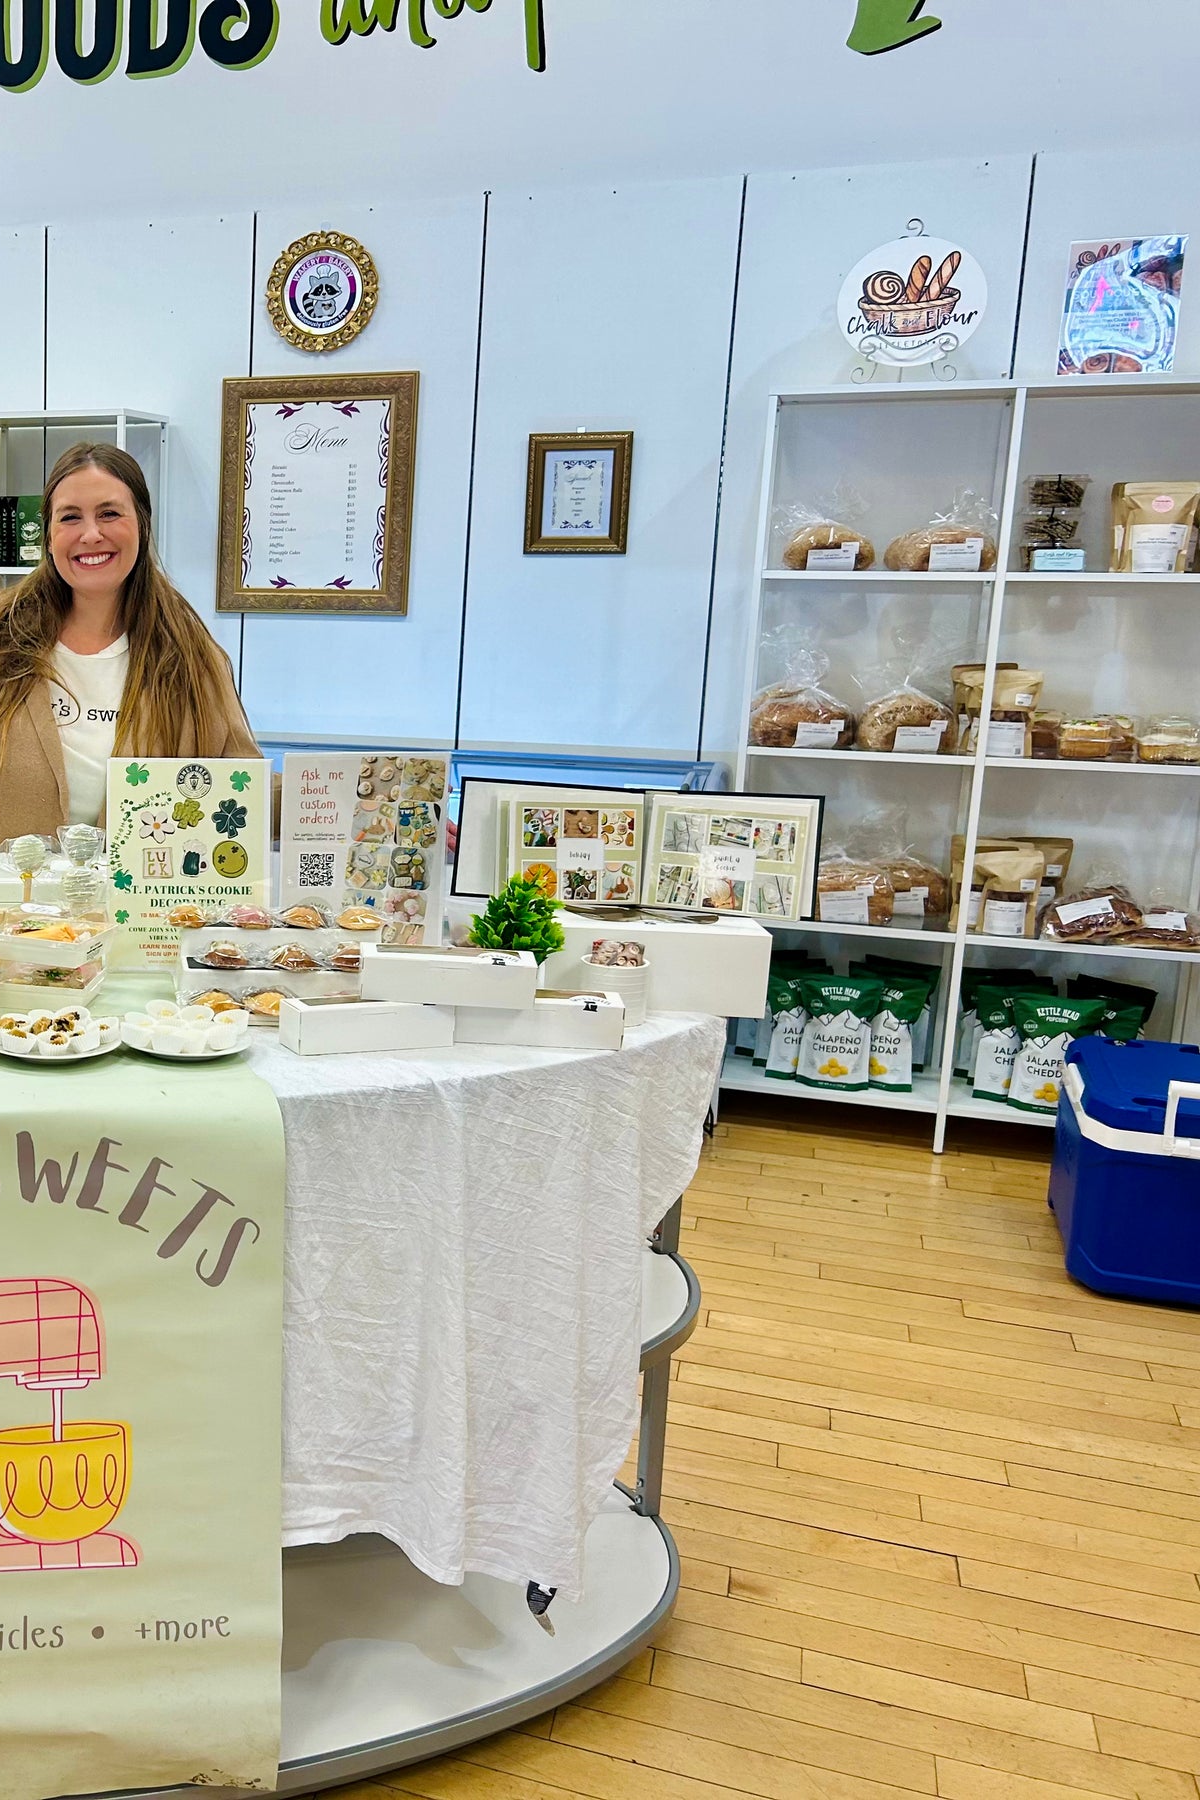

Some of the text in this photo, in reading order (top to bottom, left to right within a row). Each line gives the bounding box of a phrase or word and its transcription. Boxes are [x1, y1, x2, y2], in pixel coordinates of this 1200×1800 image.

[292, 256, 354, 281] WAKERY BAKERY
[847, 311, 898, 336] Chalk
[926, 309, 978, 330] Flour
[284, 422, 348, 455] Menu
[87, 709, 121, 722] sw
[301, 768, 344, 781] Ask me
[300, 785, 330, 795] about
[300, 800, 336, 809] custom
[299, 812, 339, 825] orders!
[144, 885, 205, 895] PATRICK'S
[208, 885, 253, 895] COOKIE
[821, 986, 861, 999] KETTLE HEAD
[1036, 1007, 1081, 1021] KETTLE HEAD
[1046, 1016, 1069, 1024] POPCORN
[812, 1043, 860, 1055] CHEDDAR
[871, 1047, 898, 1055] DDAR
[1027, 1065, 1063, 1078] CHEDD
[135, 1615, 231, 1643] +more
